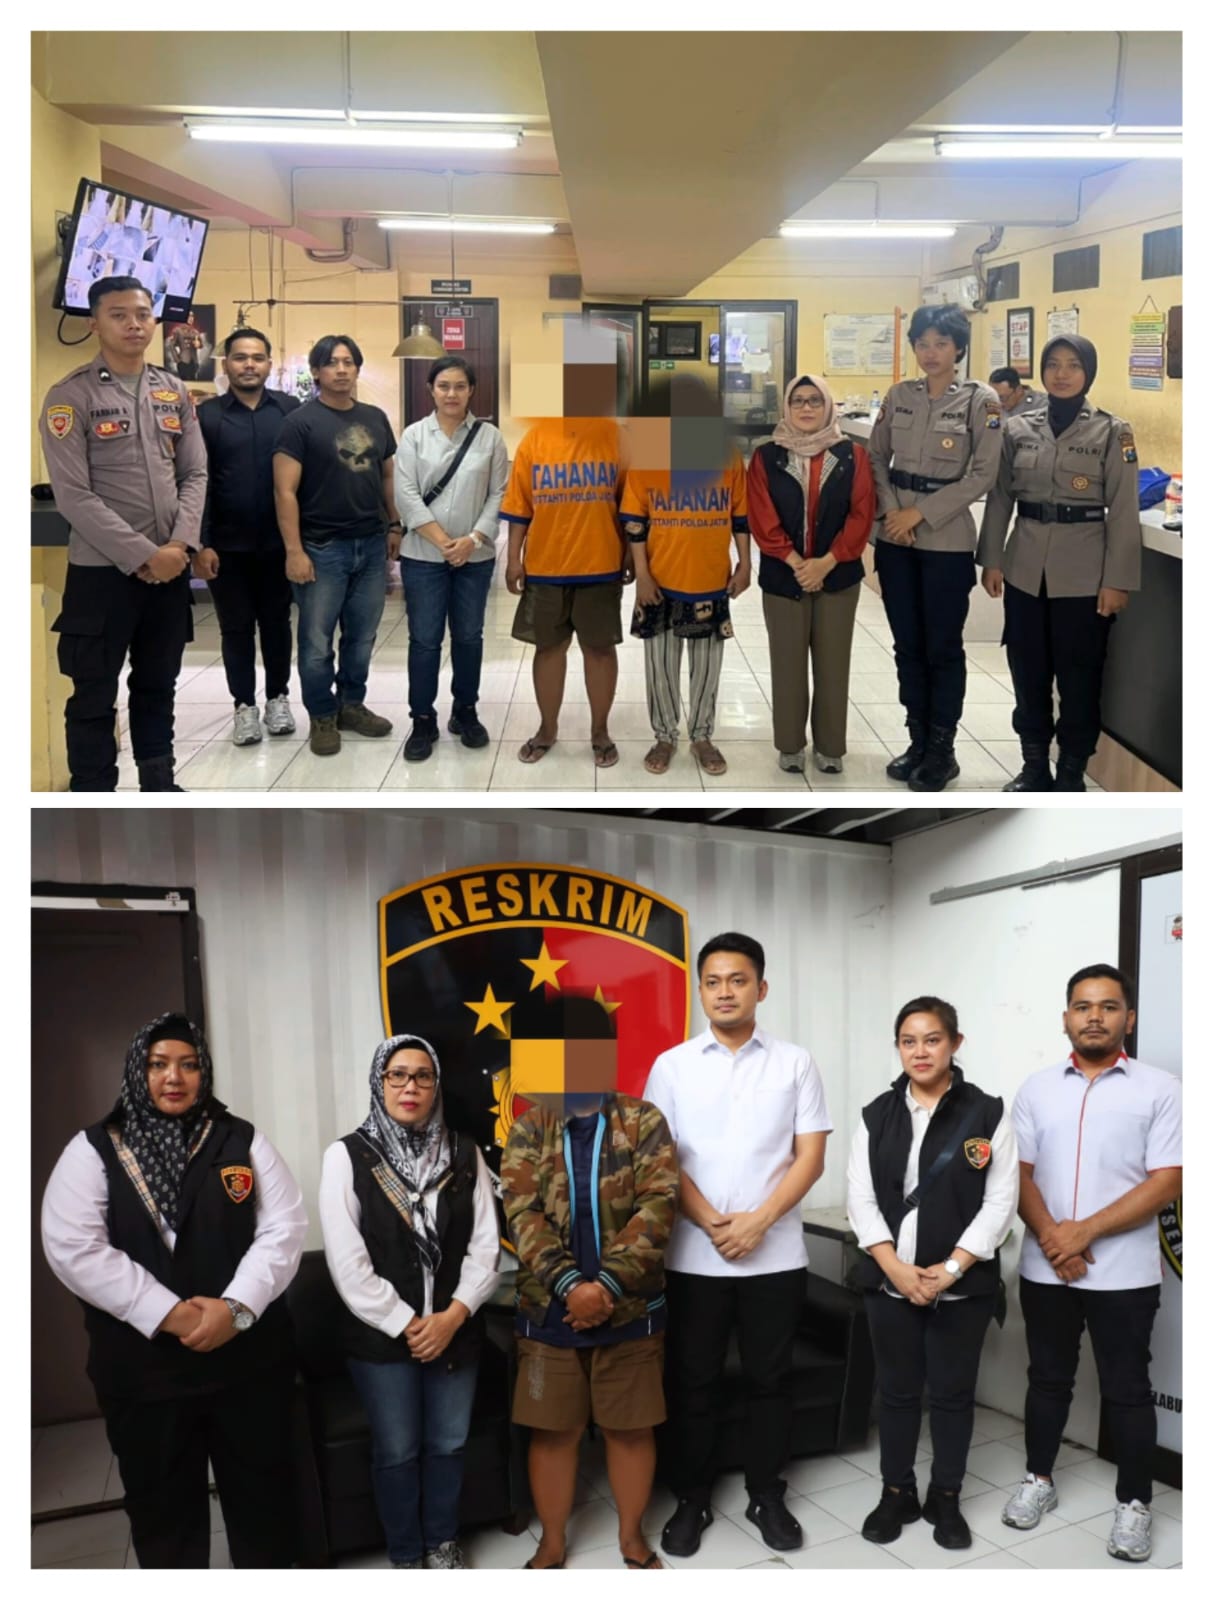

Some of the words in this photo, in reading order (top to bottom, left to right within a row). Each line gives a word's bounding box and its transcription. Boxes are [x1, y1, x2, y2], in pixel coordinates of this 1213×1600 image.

[1068, 446, 1103, 456] POLRI
[532, 462, 619, 491] TAHANAN
[646, 486, 730, 512] TAHANAN
[421, 873, 653, 939] RESKRIM
